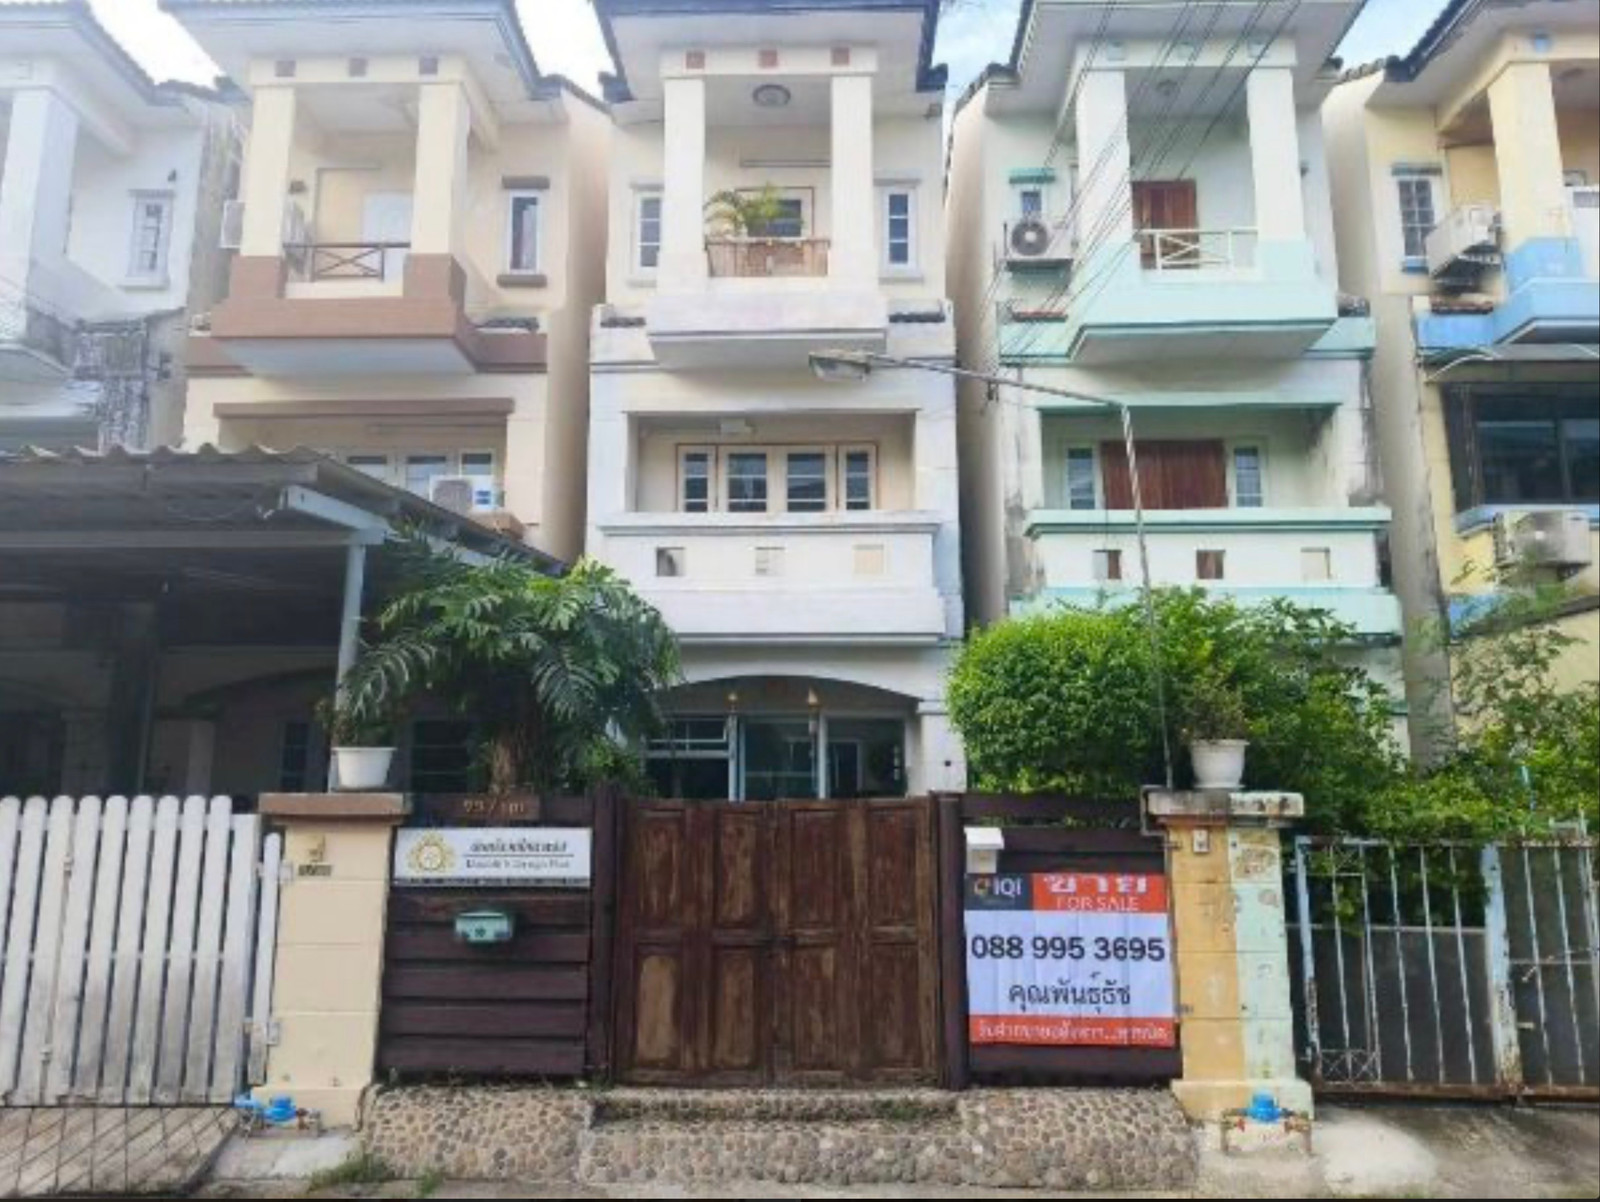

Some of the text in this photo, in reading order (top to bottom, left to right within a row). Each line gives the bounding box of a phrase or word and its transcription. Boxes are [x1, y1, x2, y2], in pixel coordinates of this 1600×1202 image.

[993, 877, 1022, 897] IQI
[1043, 874, 1148, 894] ขาย
[1056, 897, 1139, 912] FOR SALE
[971, 934, 1166, 962] 088 995 3695
